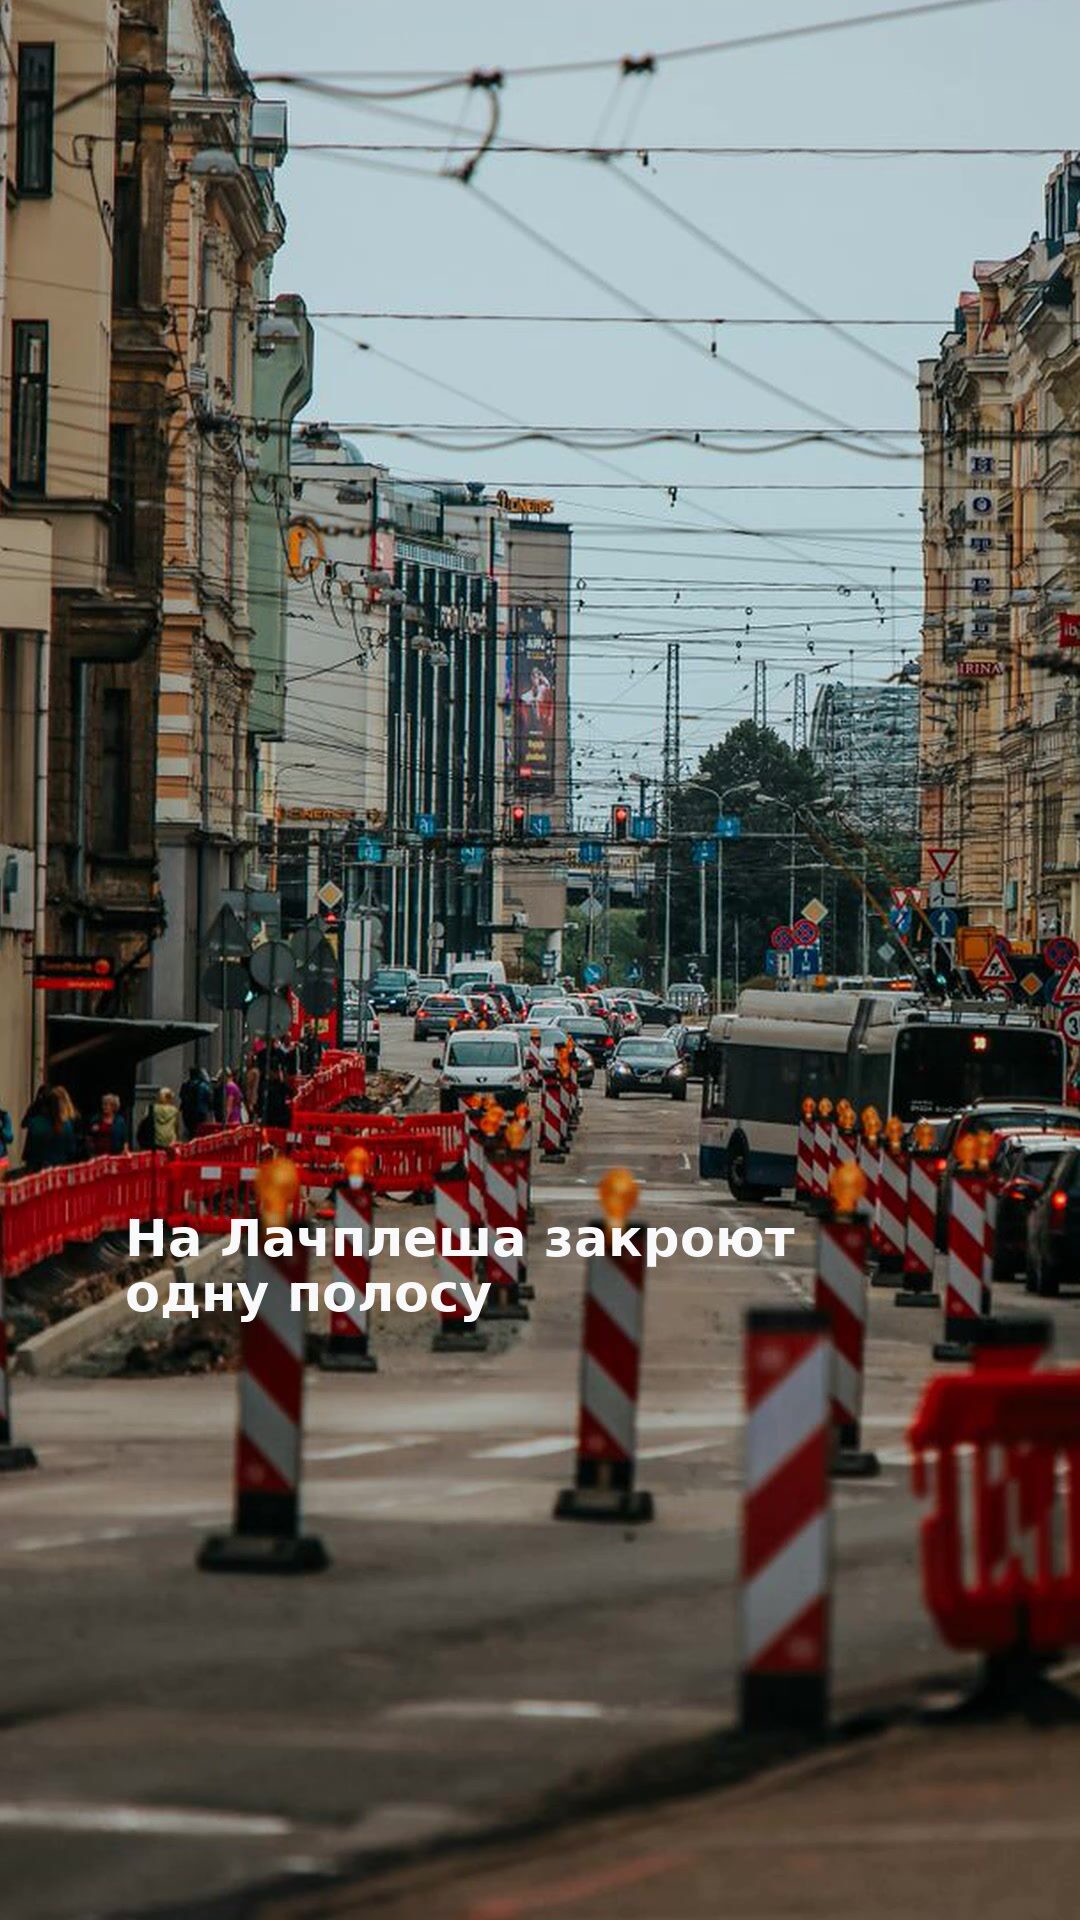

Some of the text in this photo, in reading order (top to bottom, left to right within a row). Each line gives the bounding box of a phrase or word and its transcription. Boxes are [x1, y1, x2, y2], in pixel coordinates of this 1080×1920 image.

[971, 456, 995, 635] HOTEL
[958, 662, 1002, 675] IRINA
[1068, 1016, 1080, 1036] 3
